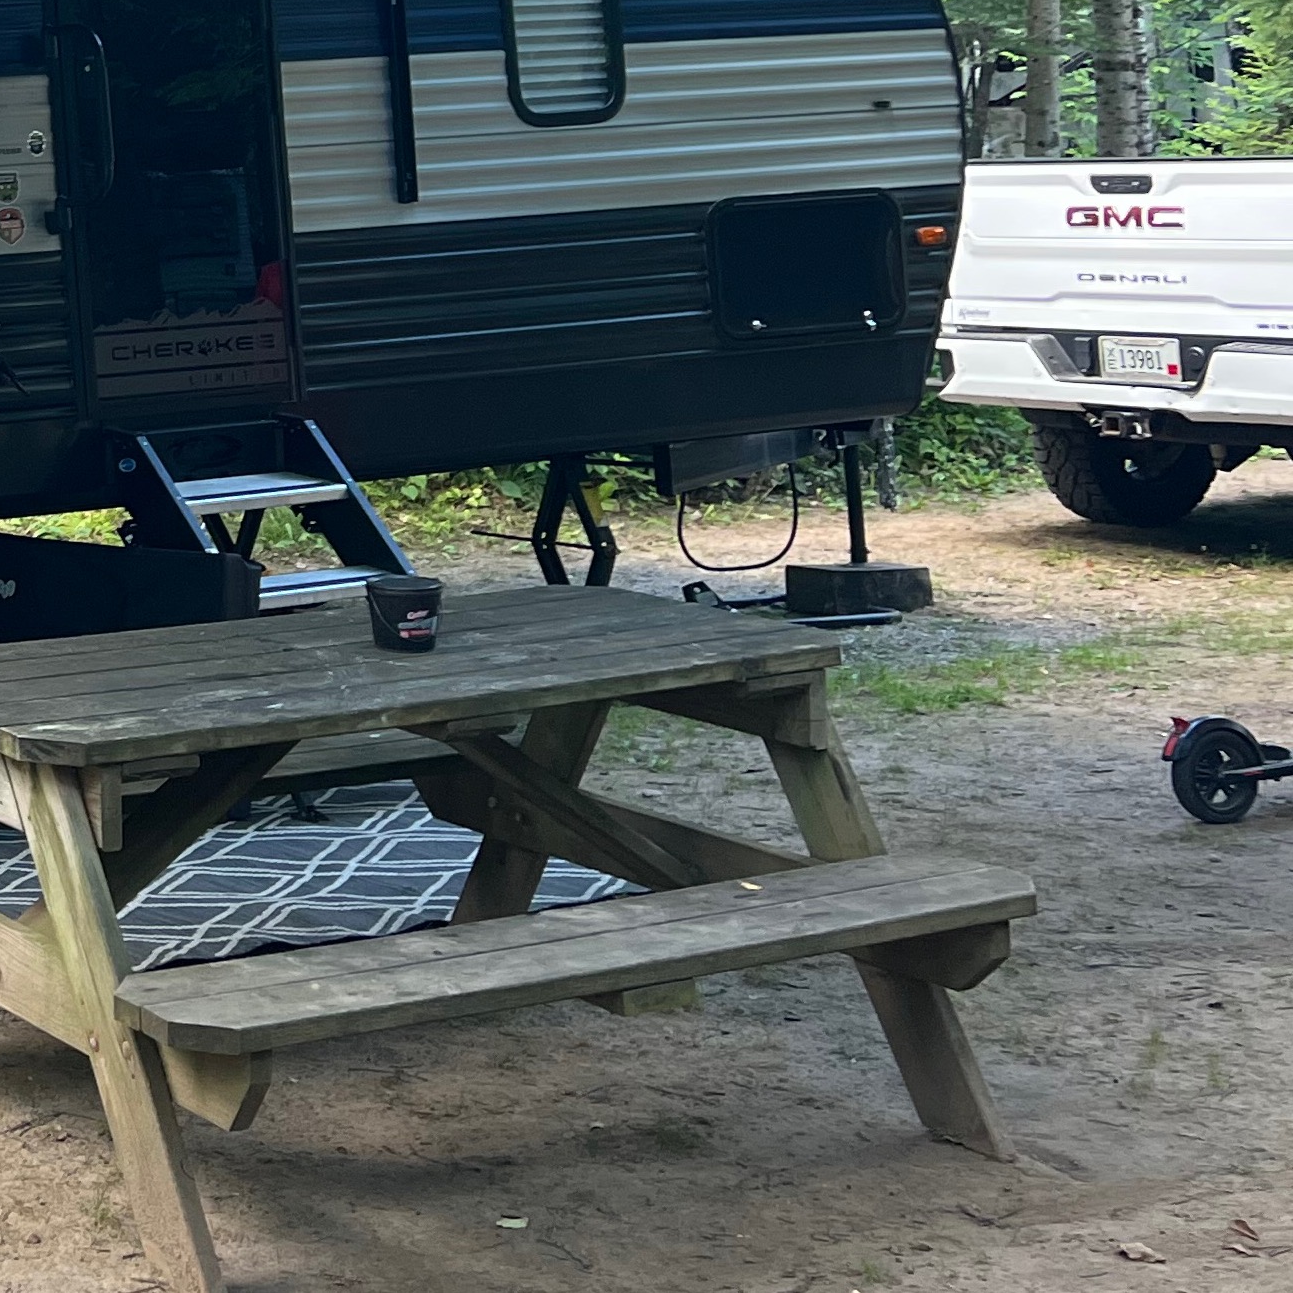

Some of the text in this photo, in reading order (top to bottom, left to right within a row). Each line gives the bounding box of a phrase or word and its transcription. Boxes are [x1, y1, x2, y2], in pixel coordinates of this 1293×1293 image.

[1066, 205, 1185, 228] GMC
[1076, 272, 1187, 284] DENALI
[110, 333, 275, 361] CHEROKEE
[1119, 348, 1164, 371] 13981
